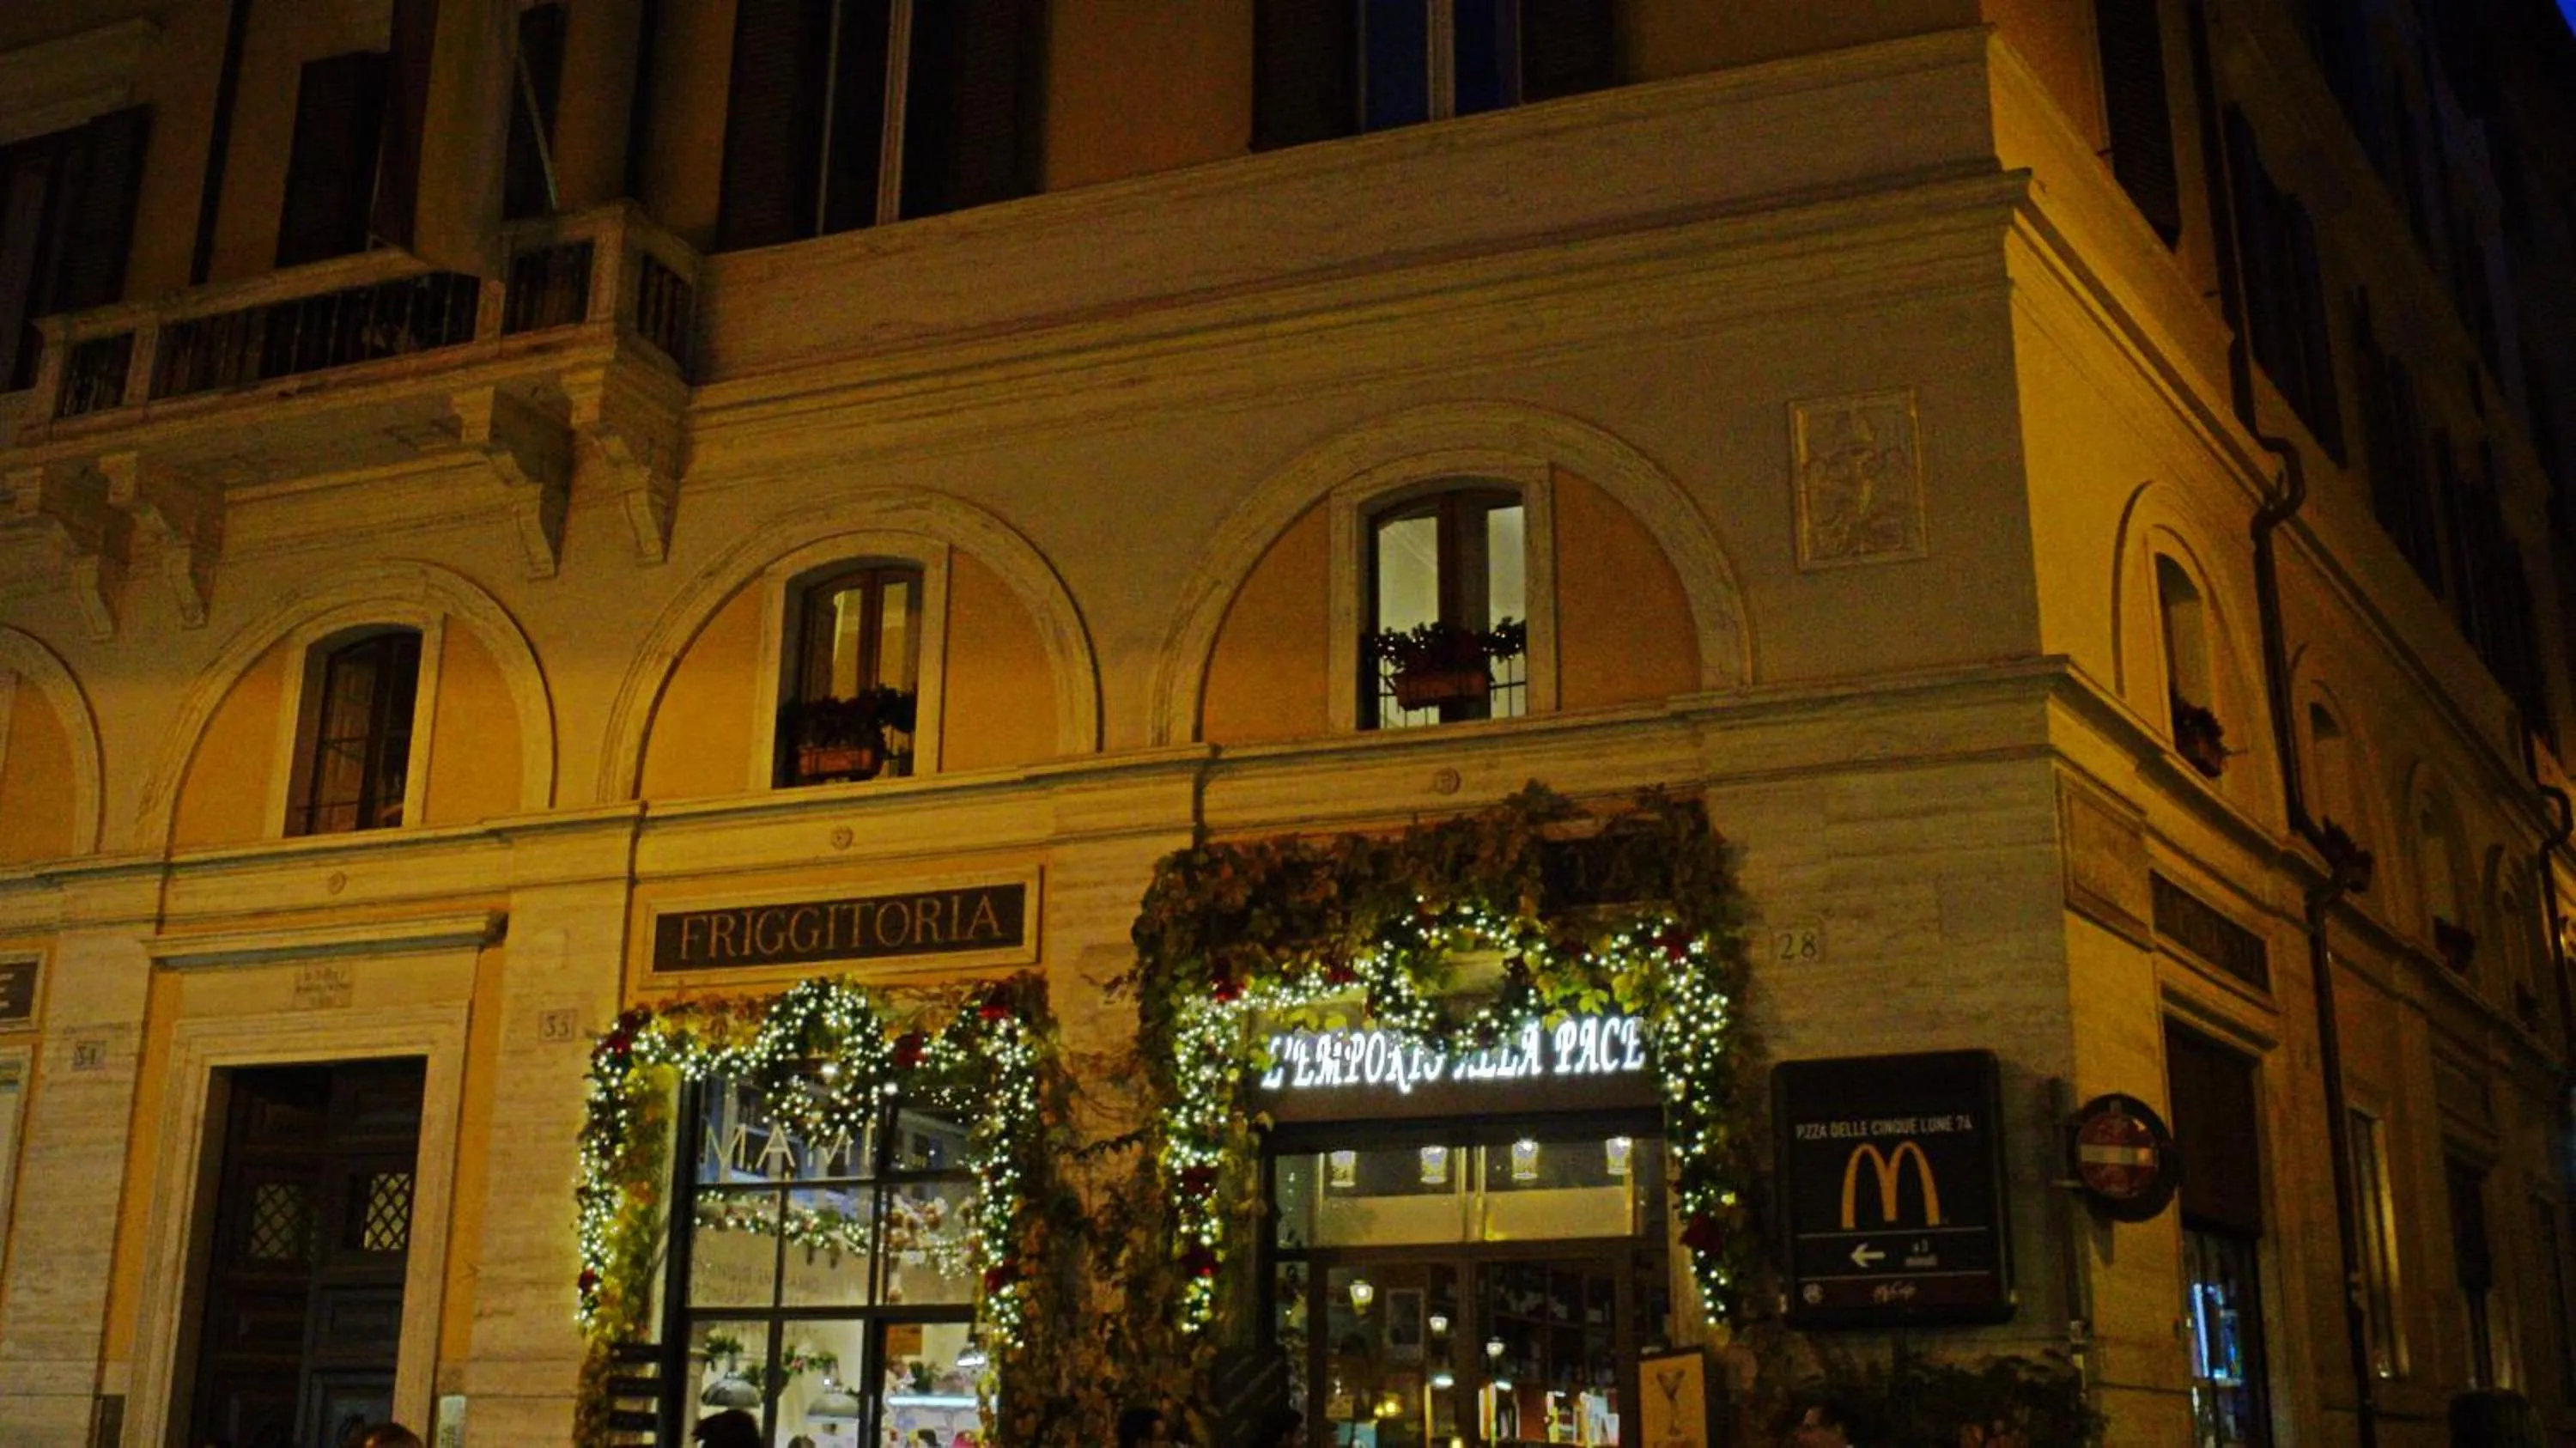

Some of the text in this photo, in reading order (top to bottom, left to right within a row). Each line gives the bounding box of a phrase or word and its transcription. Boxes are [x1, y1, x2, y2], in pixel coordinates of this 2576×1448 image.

[679, 894, 1004, 960] FRIGGITORIA
[1778, 931, 1816, 959] 28
[1552, 1016, 1647, 1074] PACE
[1830, 1121, 1868, 1138] DELLE
[1870, 1117, 1917, 1136] CINQUE
[1919, 1115, 1954, 1134] LUNE
